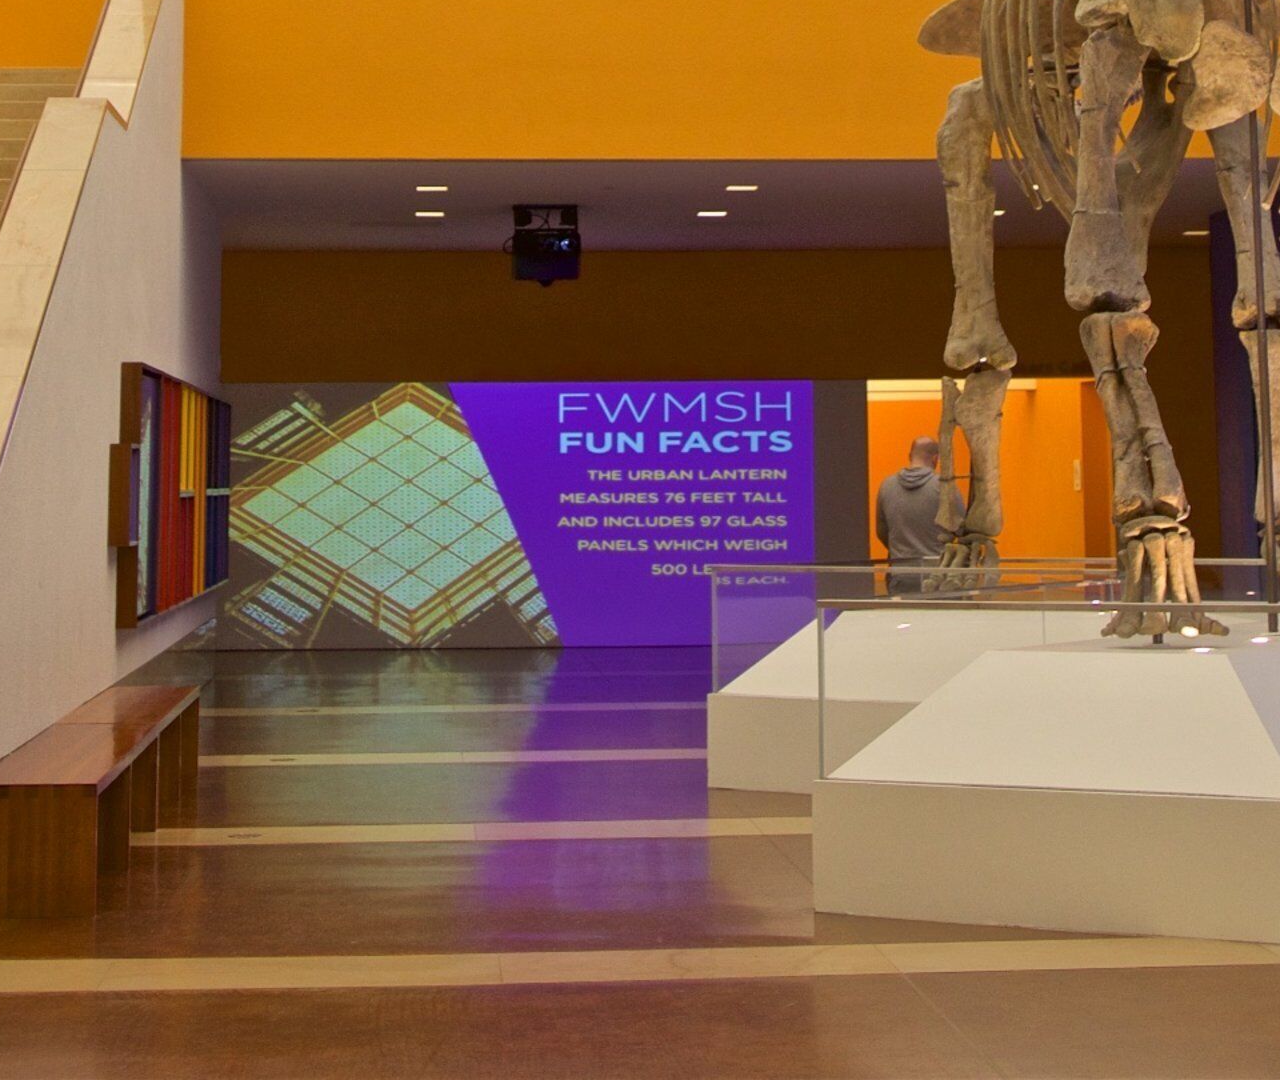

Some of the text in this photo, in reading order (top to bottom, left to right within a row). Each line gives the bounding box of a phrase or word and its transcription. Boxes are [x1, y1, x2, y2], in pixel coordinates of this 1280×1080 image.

[558, 391, 792, 424] FWMSH
[559, 430, 794, 454] FUN FACTS
[587, 469, 788, 481] THE URBAN LANTERN
[559, 491, 788, 504] MEASURES 76 FEET TALL
[557, 515, 788, 528] AND INCLUDES 97 GLASS
[577, 539, 788, 552] PANELS WHICH WEIGH
[651, 563, 687, 575] 500
